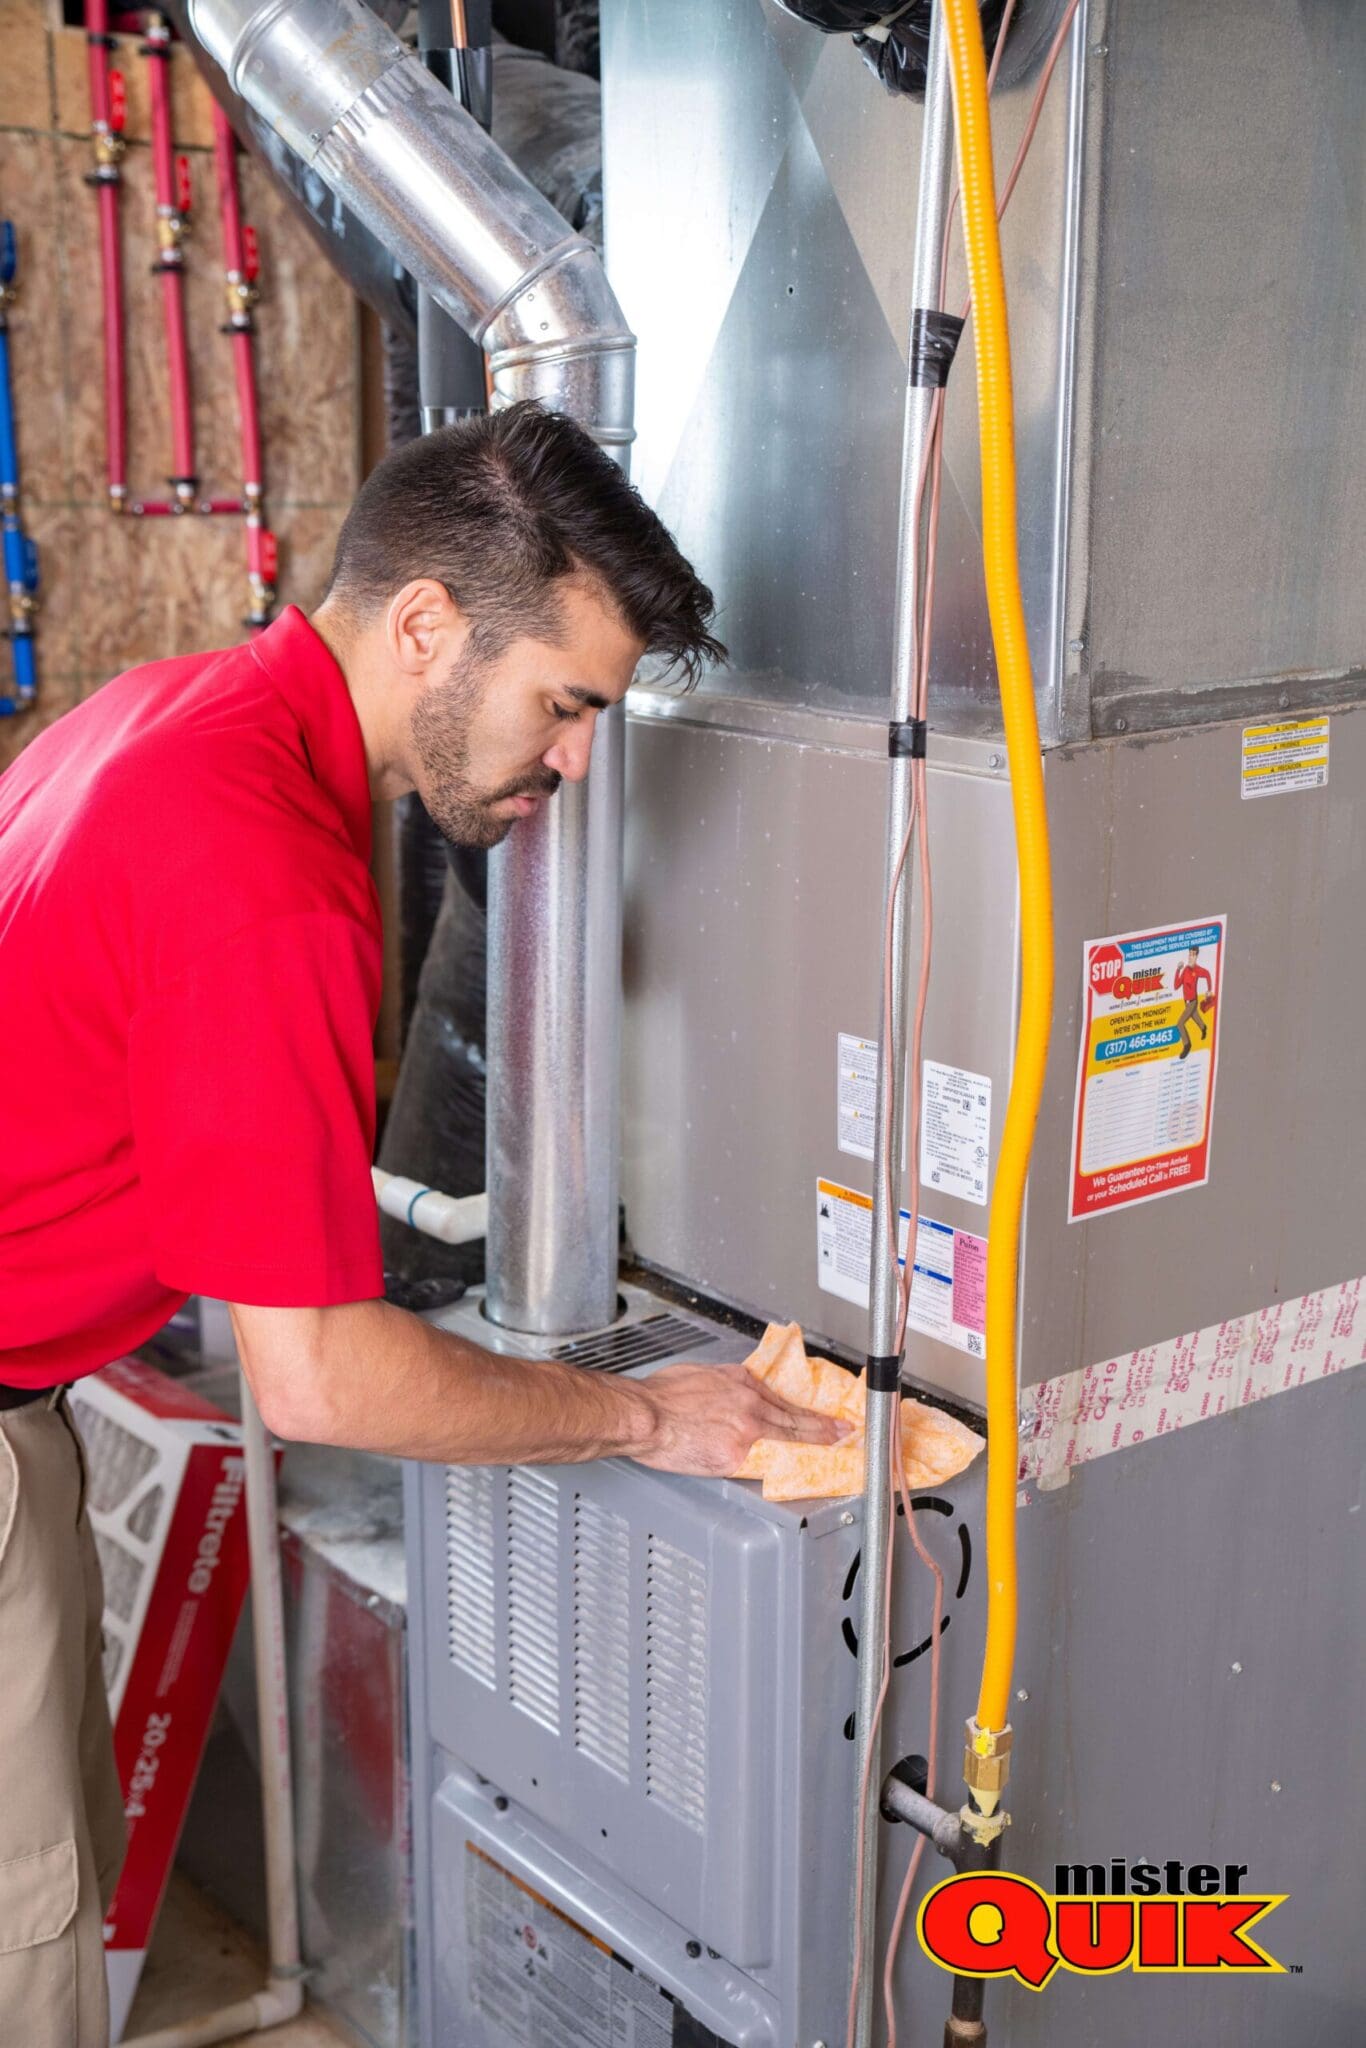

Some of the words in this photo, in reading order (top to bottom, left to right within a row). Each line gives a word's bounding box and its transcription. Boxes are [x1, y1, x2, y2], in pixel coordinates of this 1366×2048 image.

[1092, 958, 1121, 982] STOP
[1132, 967, 1162, 980] mister
[1112, 974, 1165, 1000] QUIK
[1109, 1018, 1125, 1026] OPEN
[1126, 1013, 1141, 1022] UNTIL
[1132, 1023, 1140, 1031] ON
[1141, 1020, 1152, 1029] THE
[1153, 1018, 1166, 1026] WAY
[1105, 1040, 1127, 1057] (317)
[1128, 1029, 1173, 1050] 466-8463
[1087, 1194, 1094, 1202] or
[1094, 1190, 1107, 1202] your
[1108, 1178, 1147, 1196] Scheduled
[1148, 1170, 1162, 1184] Call
[1169, 1164, 1191, 1178] FREE!
[1092, 1177, 1106, 1188] We
[1107, 1167, 1145, 1184] Guarantee
[1146, 1161, 1169, 1174] On-Time
[1170, 1154, 1189, 1167] Arrival
[1283, 1363, 1293, 1387] 0800
[1243, 1378, 1252, 1403] 0800
[1201, 1392, 1210, 1416] 0800
[1157, 1408, 1167, 1433] 0800
[1112, 1422, 1122, 1447] 0800
[1132, 1430, 1144, 1442] 9
[187, 1456, 246, 1594] Filtrete
